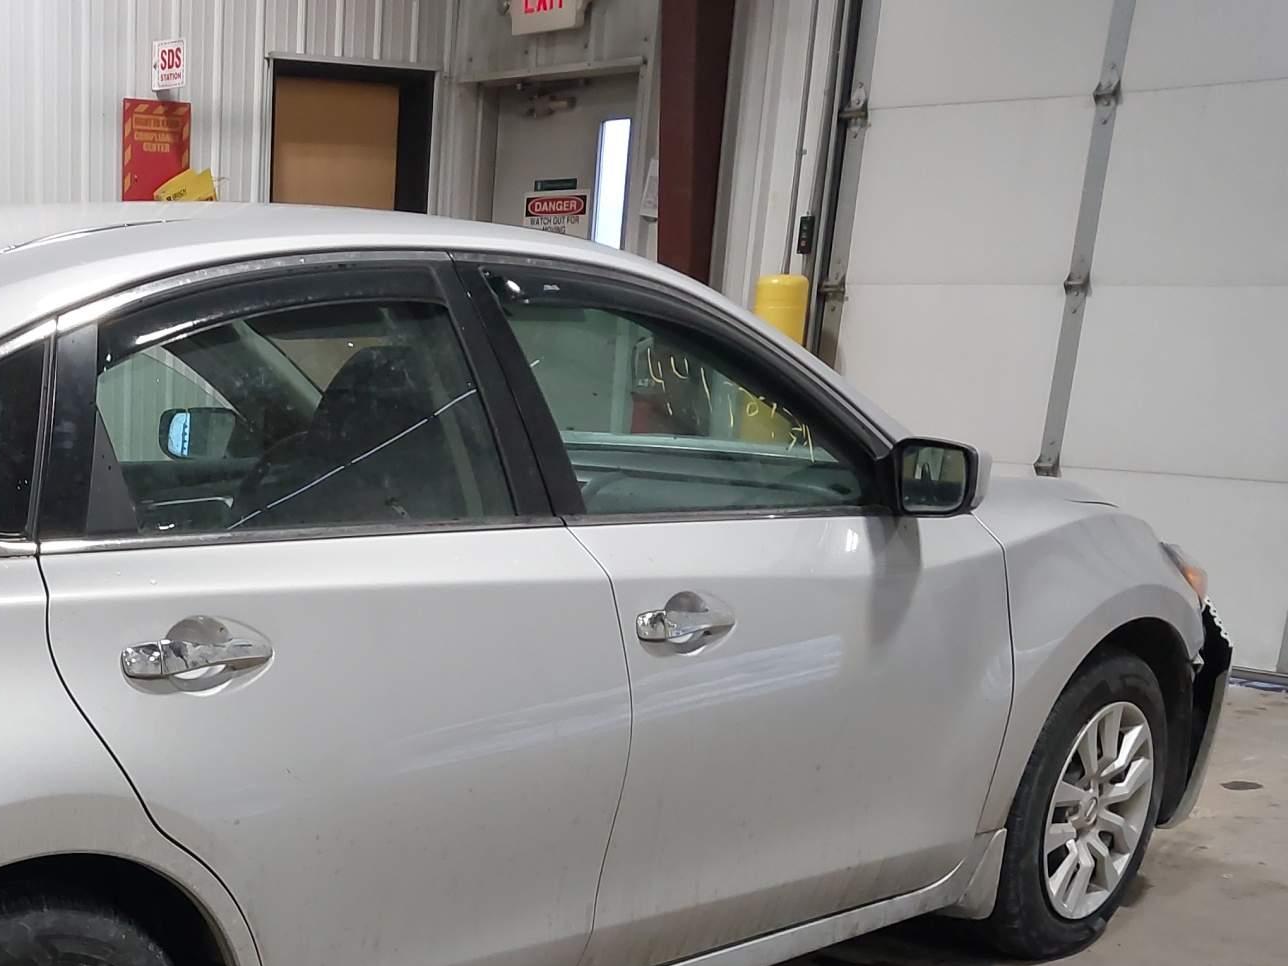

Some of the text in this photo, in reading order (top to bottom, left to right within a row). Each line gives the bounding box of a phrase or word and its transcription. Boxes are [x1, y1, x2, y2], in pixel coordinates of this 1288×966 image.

[161, 47, 181, 70] SDS
[161, 72, 181, 81] STATION
[534, 200, 577, 212] DANGER
[530, 215, 579, 225] WATCH OUT FOR
